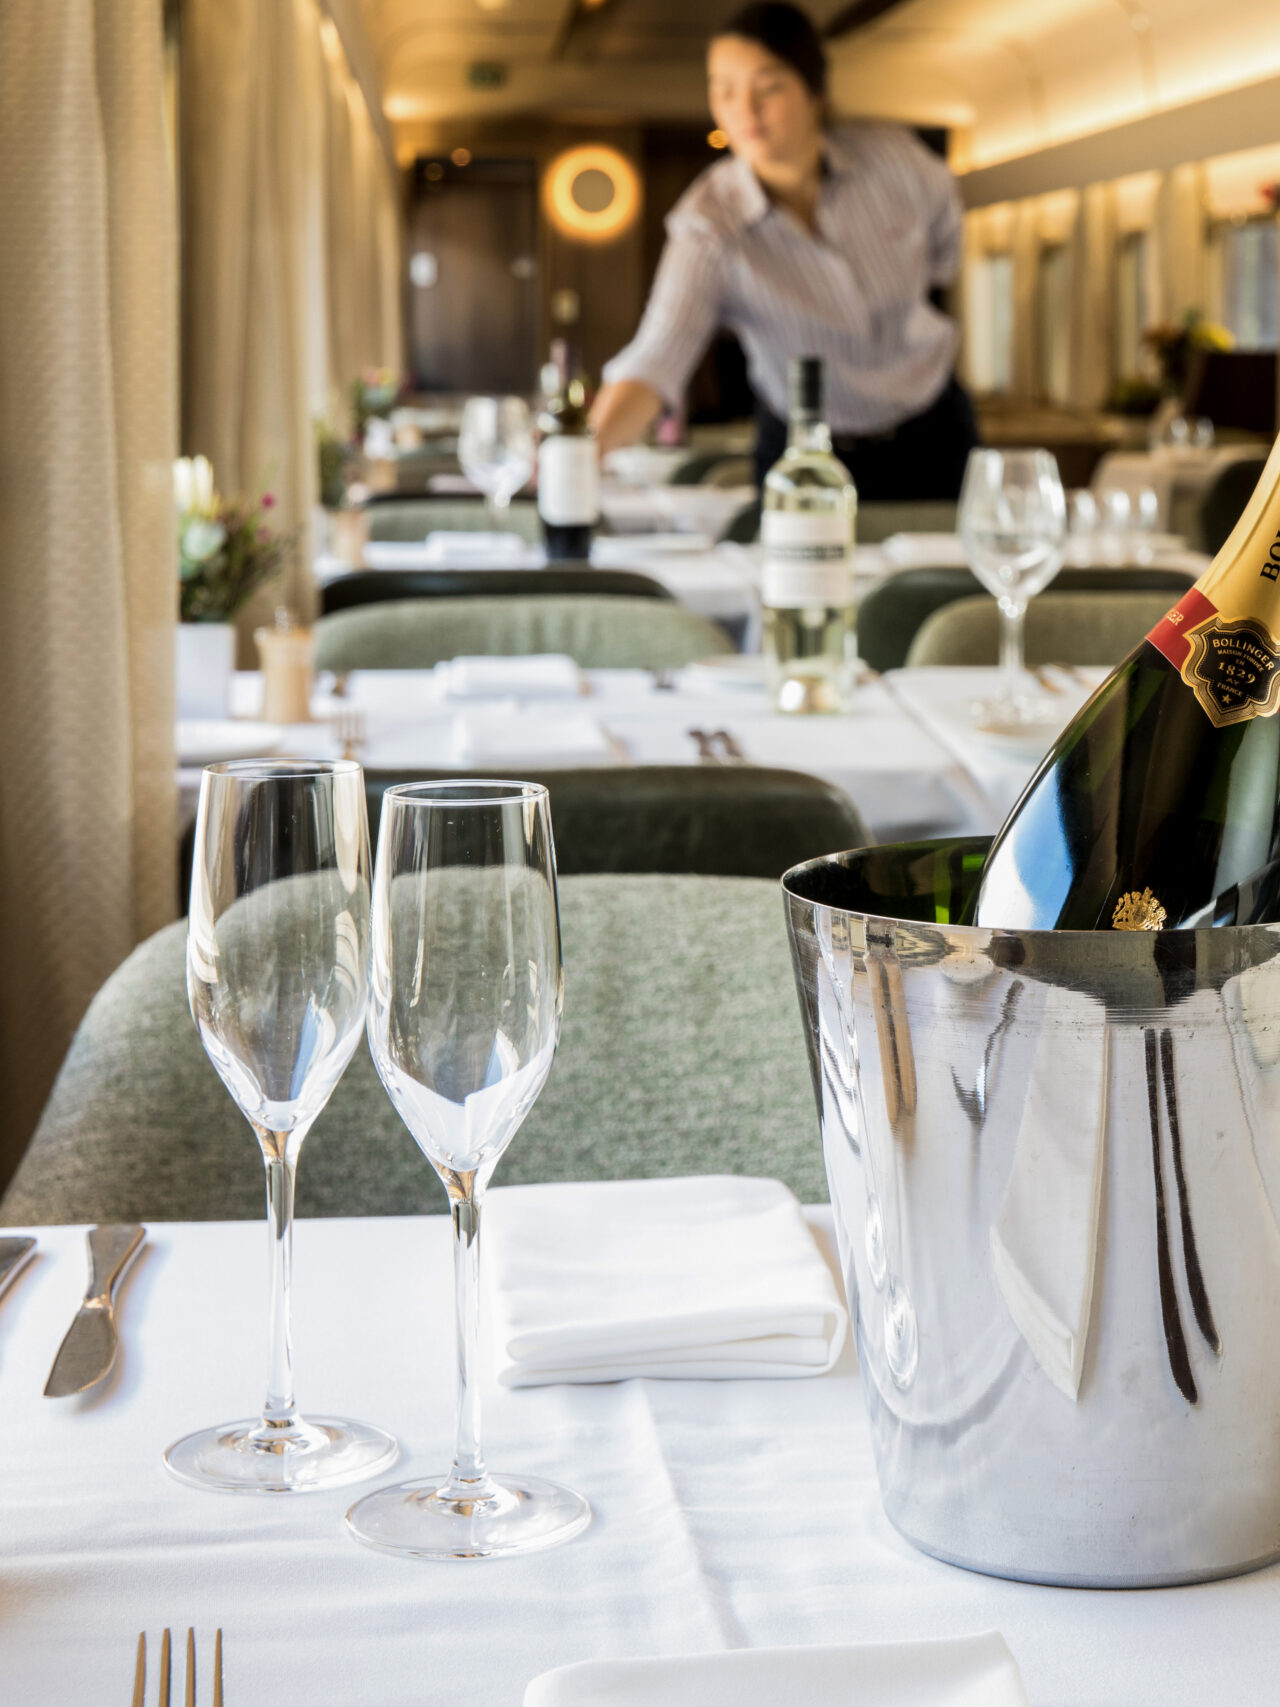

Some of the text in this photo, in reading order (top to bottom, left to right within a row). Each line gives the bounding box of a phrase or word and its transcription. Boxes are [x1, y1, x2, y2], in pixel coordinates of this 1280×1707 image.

[1212, 638, 1275, 671] BOLLINGER
[1218, 662, 1256, 684] 1829
[1217, 682, 1243, 697] FRANCE
